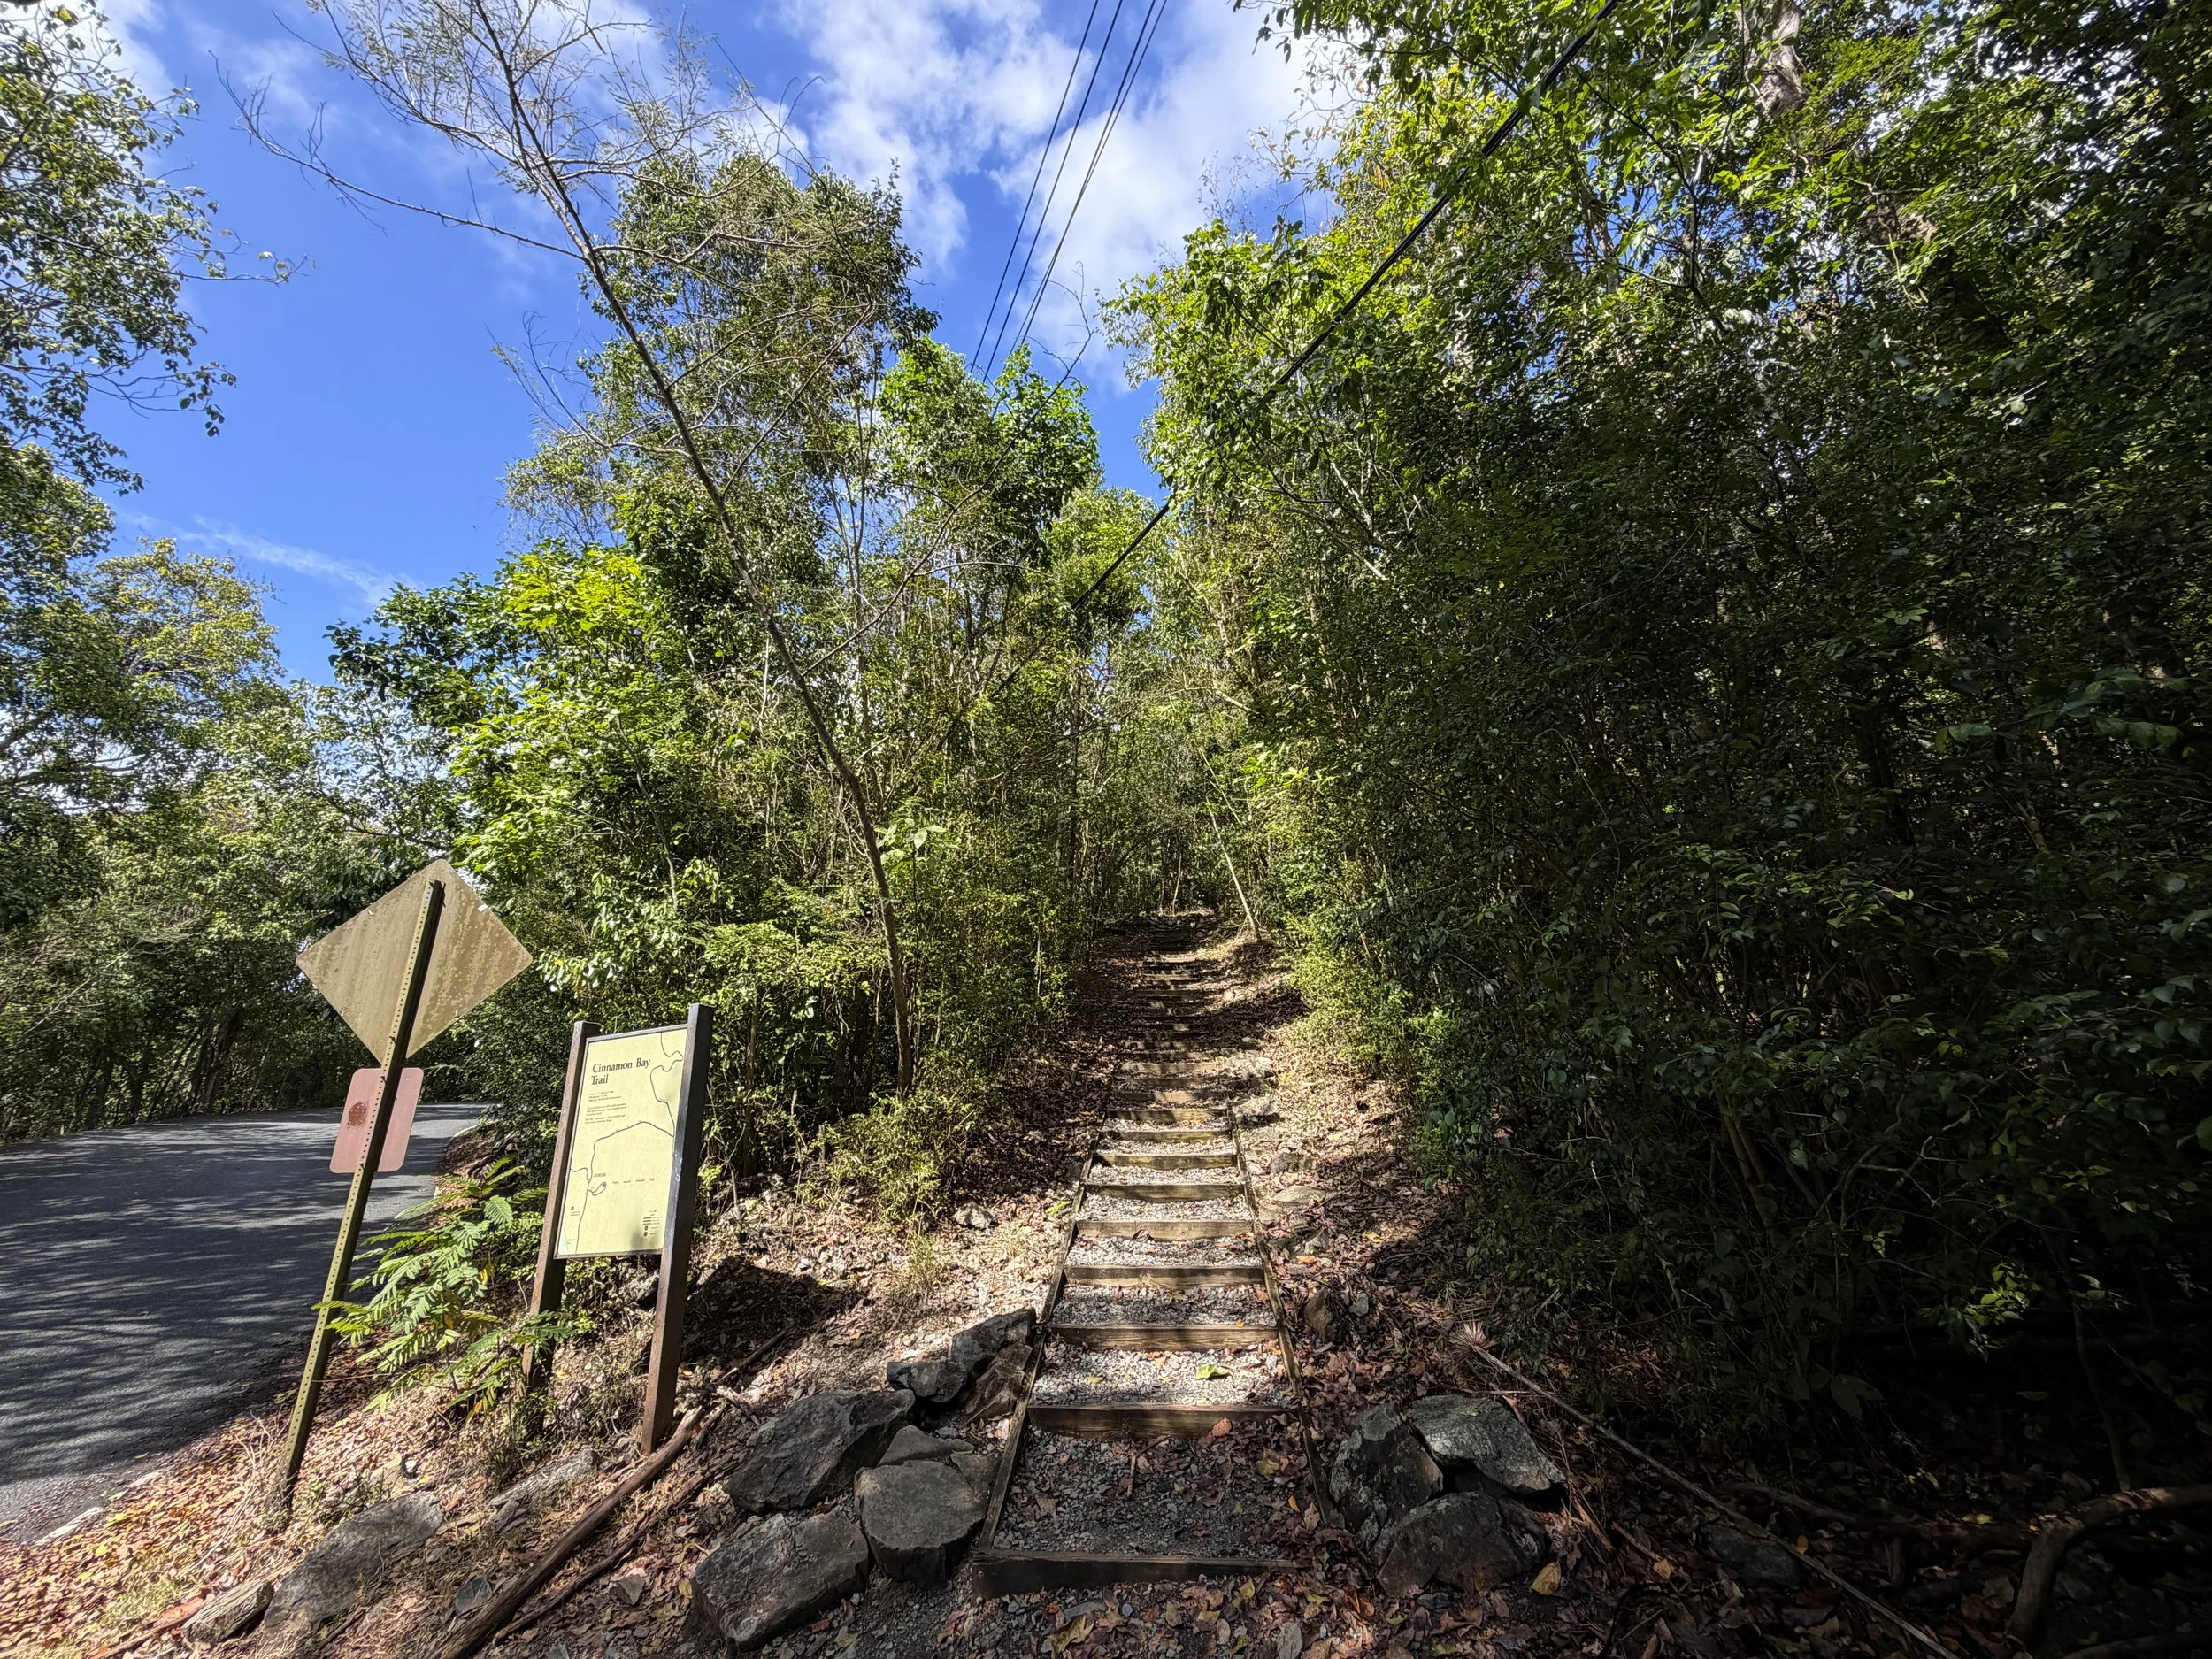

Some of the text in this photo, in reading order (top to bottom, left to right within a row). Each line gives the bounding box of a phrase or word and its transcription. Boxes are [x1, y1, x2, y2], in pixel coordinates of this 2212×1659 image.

[592, 1057, 651, 1073] Cinnamon Bay
[591, 1073, 609, 1085] Trail
